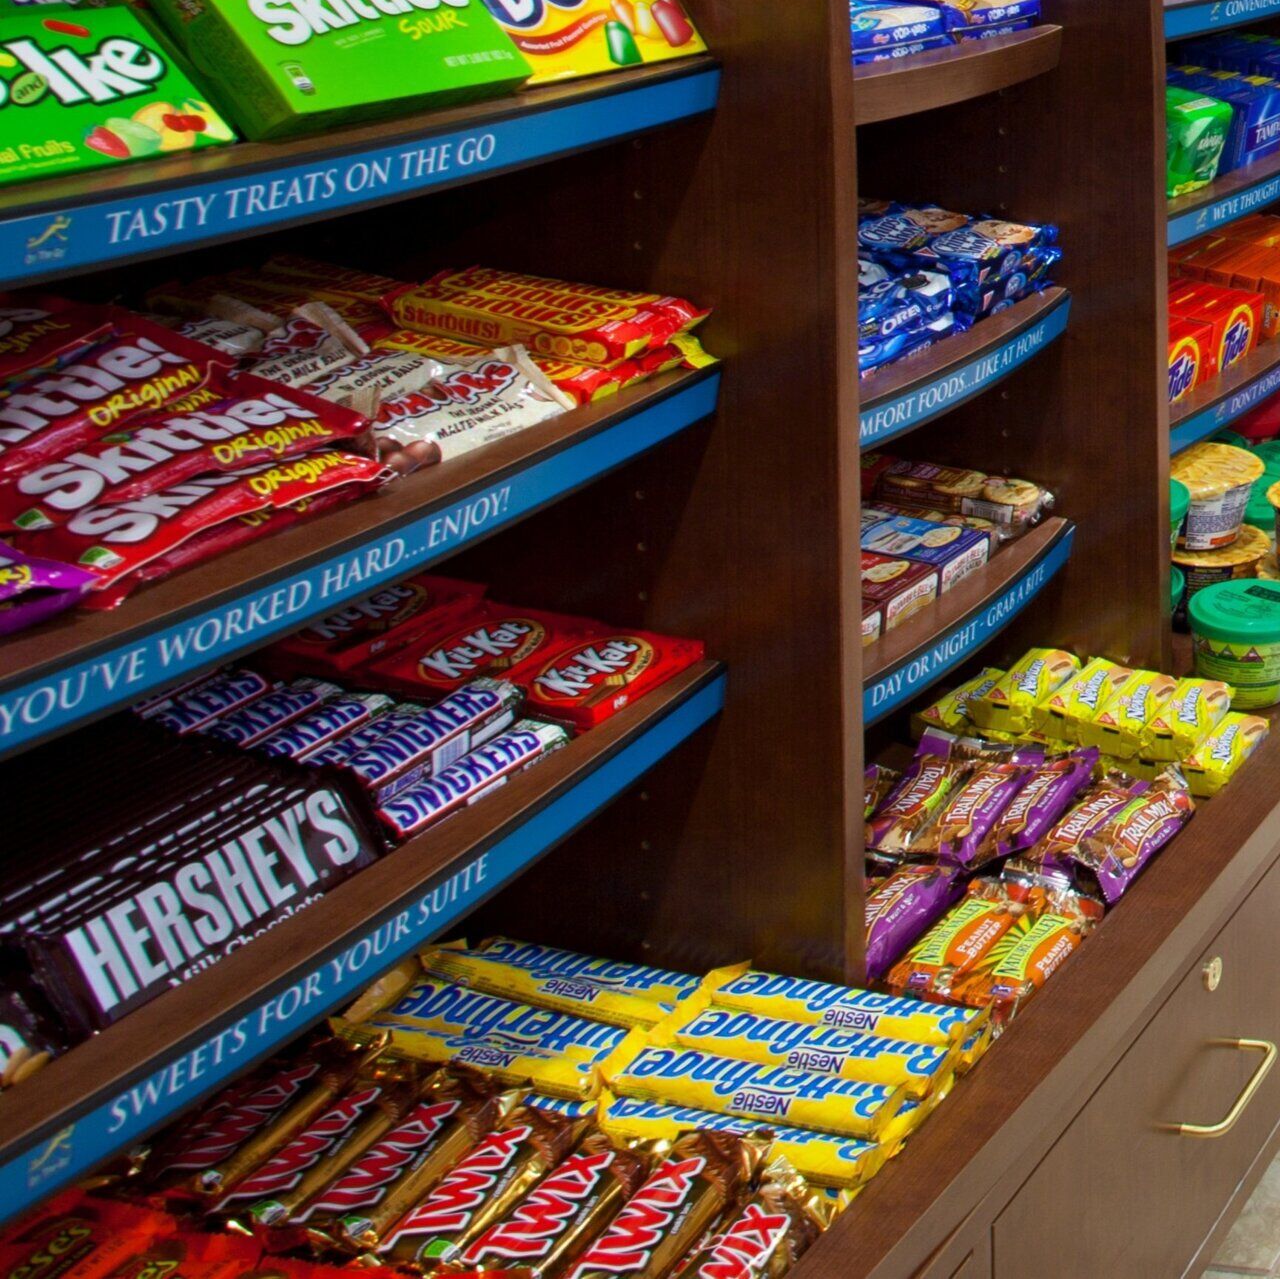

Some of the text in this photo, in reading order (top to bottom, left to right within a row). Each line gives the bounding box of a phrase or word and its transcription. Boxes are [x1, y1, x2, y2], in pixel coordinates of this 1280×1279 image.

[14, 71, 46, 100] and
[20, 139, 76, 160] Fruits
[105, 133, 497, 245] TASTY TREATS ON THE GO
[1240, 180, 1279, 211] THOUGHT
[1001, 348, 1016, 367] AT
[1016, 325, 1047, 360] HOME
[1222, 318, 1250, 370] Tide
[1168, 352, 1197, 402] Tide
[1231, 385, 1261, 414] DON'T
[0, 646, 148, 735] YOU'VE
[158, 579, 312, 668] WORKED
[871, 563, 1047, 708] DAY OR NIGHT GRAB A BITE
[348, 685, 502, 781] SNICKERS
[384, 727, 542, 830] SNICKERS
[893, 764, 946, 813] TRAIL MIX
[946, 772, 1002, 824] TRAIL MIX
[1001, 773, 1053, 825] TRAIL MIX
[1055, 794, 1122, 842] TRAIL MIX
[1120, 799, 1174, 846] TRAIL MIX
[65, 788, 360, 1014] HERSHEY'S
[887, 875, 916, 902] MIX
[919, 900, 992, 966] NATURE VALLEY
[956, 918, 995, 954] PEANUT
[967, 921, 1003, 960] BUTTER
[1000, 914, 1066, 979] NATURE VALLEY
[1035, 935, 1071, 972] PEANUT
[107, 851, 490, 1135] SWEETS FOR YOUR SUITE
[205, 1086, 382, 1216] TWIX
[287, 1099, 463, 1223] TWIX
[377, 1124, 533, 1256] TWIX
[460, 1150, 616, 1267] TWIX
[560, 1155, 707, 1279] TWIX
